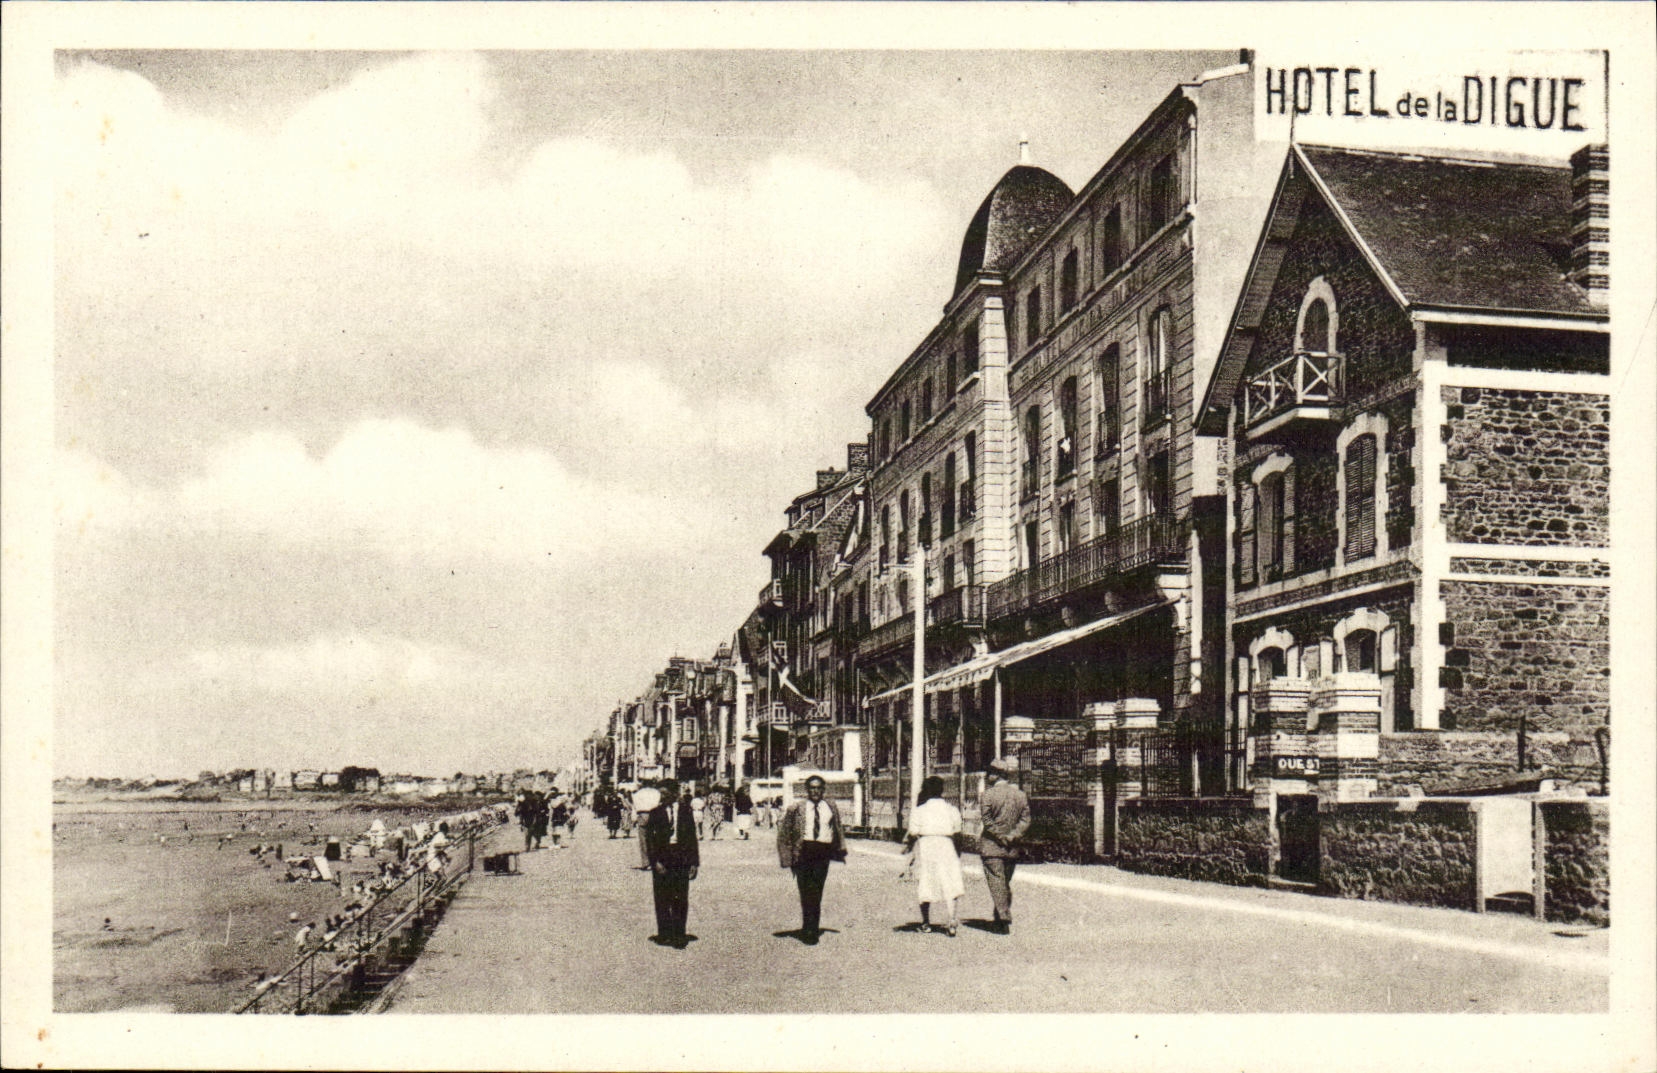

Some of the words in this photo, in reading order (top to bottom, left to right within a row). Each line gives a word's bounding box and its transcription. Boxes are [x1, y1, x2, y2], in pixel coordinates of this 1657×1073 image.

[1266, 67, 1390, 117] HOTEL
[1396, 92, 1429, 118] de
[1437, 92, 1457, 122] la
[1464, 76, 1585, 132] DIGUE
